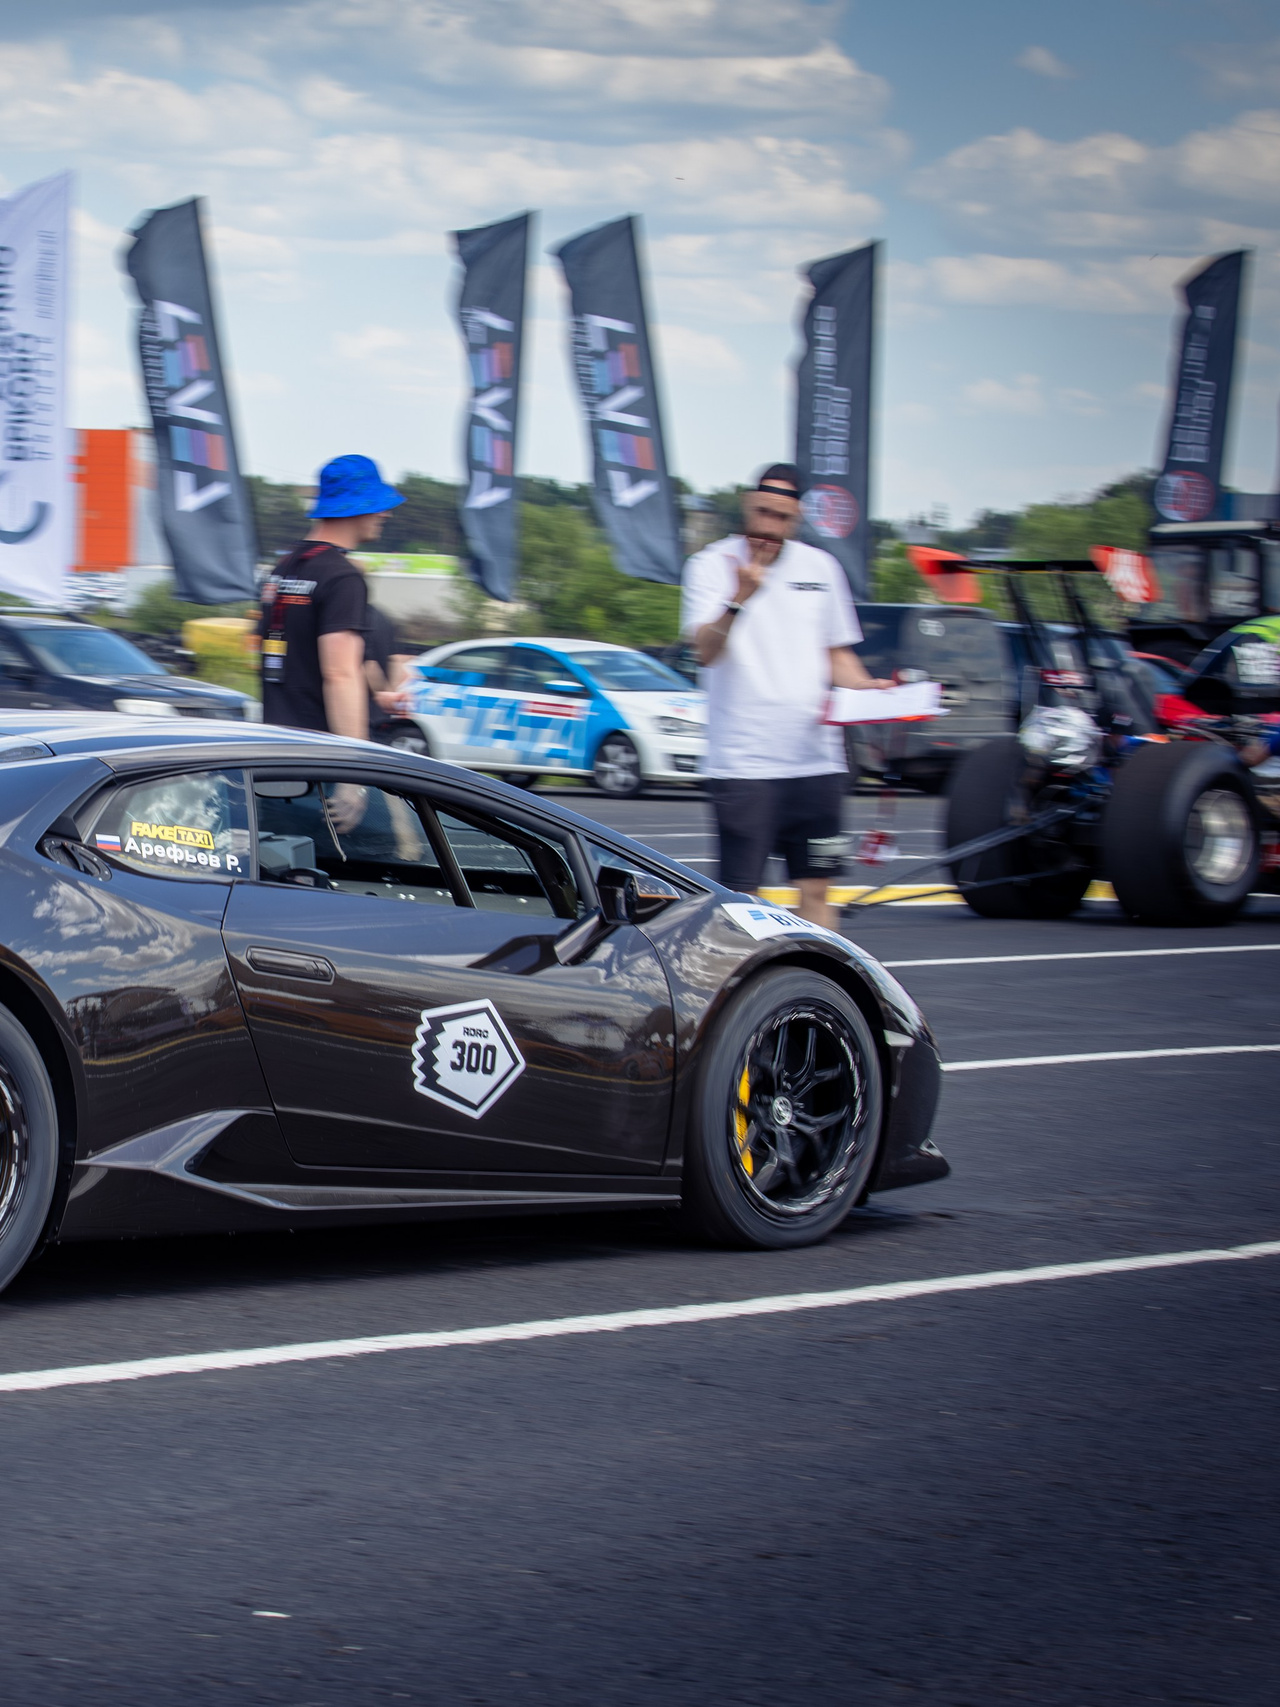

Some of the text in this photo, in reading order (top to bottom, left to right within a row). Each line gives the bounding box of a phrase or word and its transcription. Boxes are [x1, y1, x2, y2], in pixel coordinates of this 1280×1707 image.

[131, 821, 210, 847] FAKE TAXI
[124, 837, 221, 868] Арефьев
[226, 853, 243, 873] Р.
[450, 1039, 497, 1075] 300
